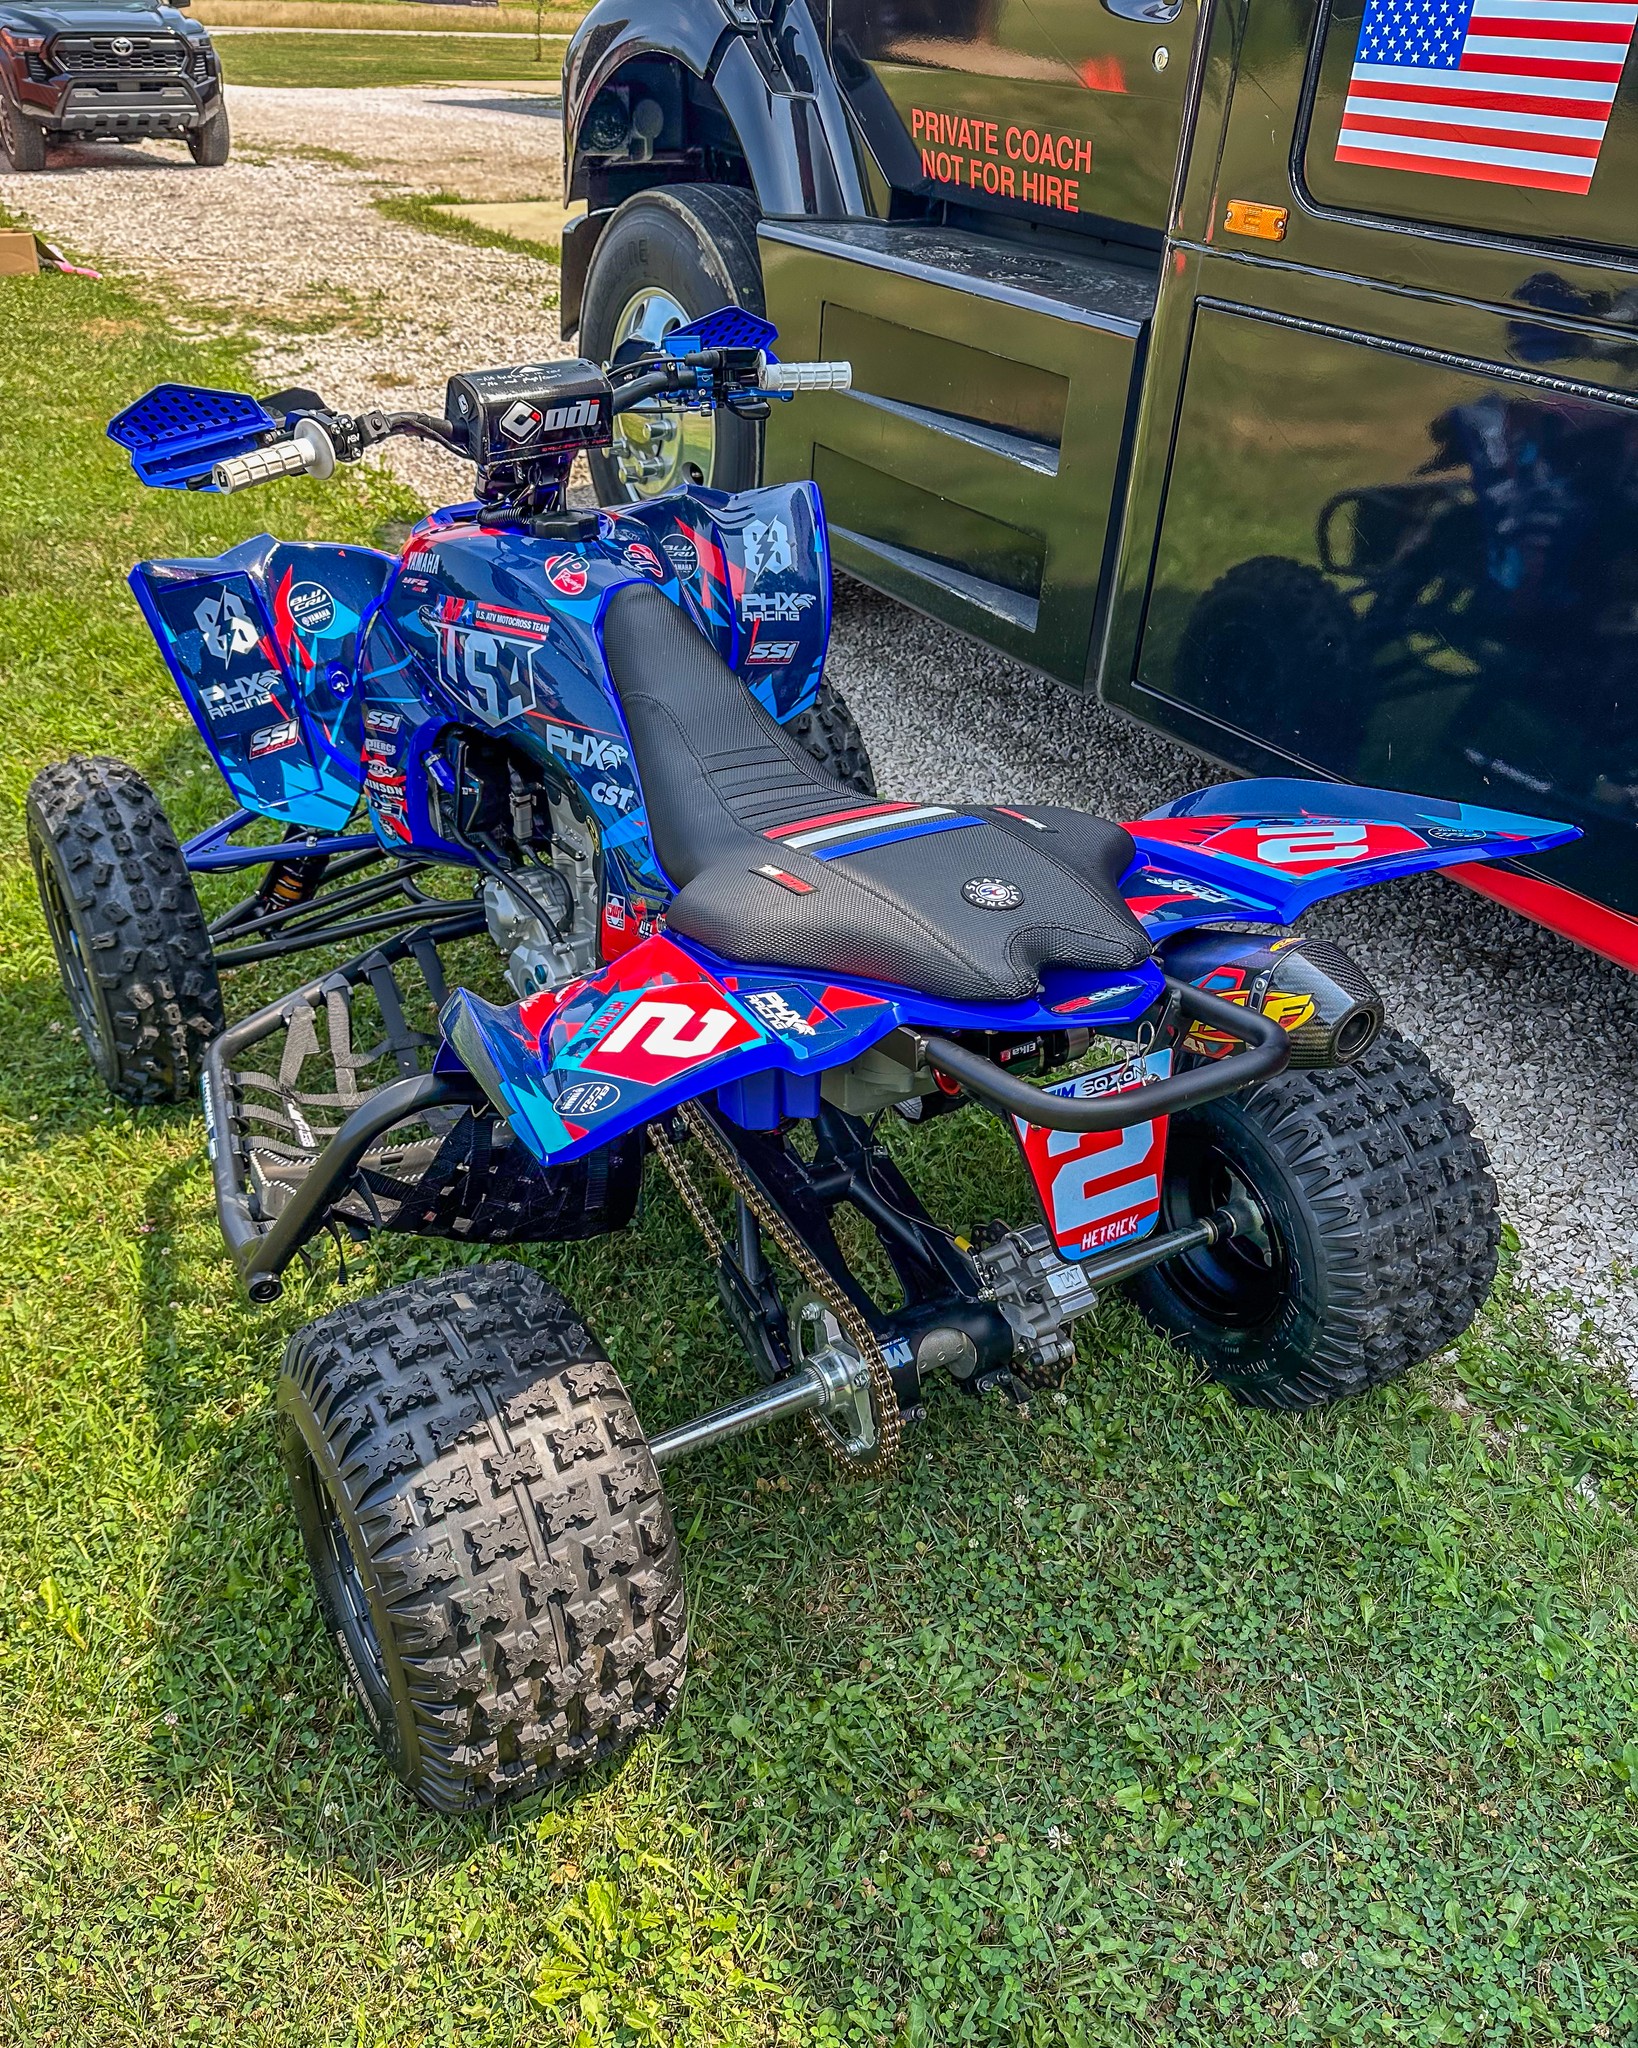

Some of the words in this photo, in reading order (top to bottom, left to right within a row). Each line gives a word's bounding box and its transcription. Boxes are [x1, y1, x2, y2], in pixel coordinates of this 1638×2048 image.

[911, 108, 999, 156] PRIVATE
[1005, 126, 1092, 174] COACH
[921, 148, 964, 186] NOT
[970, 158, 1015, 199] FOR
[1023, 170, 1079, 213] HIRE
[407, 551, 440, 575] YAMAHA
[290, 589, 322, 607] BLU
[293, 594, 327, 612] CRU
[741, 592, 799, 612] PHX
[307, 608, 332, 623] YAMAHA
[486, 612, 497, 622] ATV
[497, 615, 532, 630] MOTOCROSS
[532, 621, 550, 633] TEAM
[742, 611, 800, 622] RACING
[750, 643, 797, 659] SSI
[200, 673, 270, 710] PHX
[208, 690, 272, 721] RACING
[366, 710, 400, 730] SSI
[252, 720, 297, 751] SSI
[546, 724, 611, 771] PHX
[1257, 825, 1369, 864] 2
[965, 878, 1003, 891] SEAT
[969, 884, 1020, 907] CONCEPTS
[597, 1001, 737, 1058] 2
[1047, 1120, 1159, 1234] 2
[1081, 1213, 1139, 1251] HETRICK
